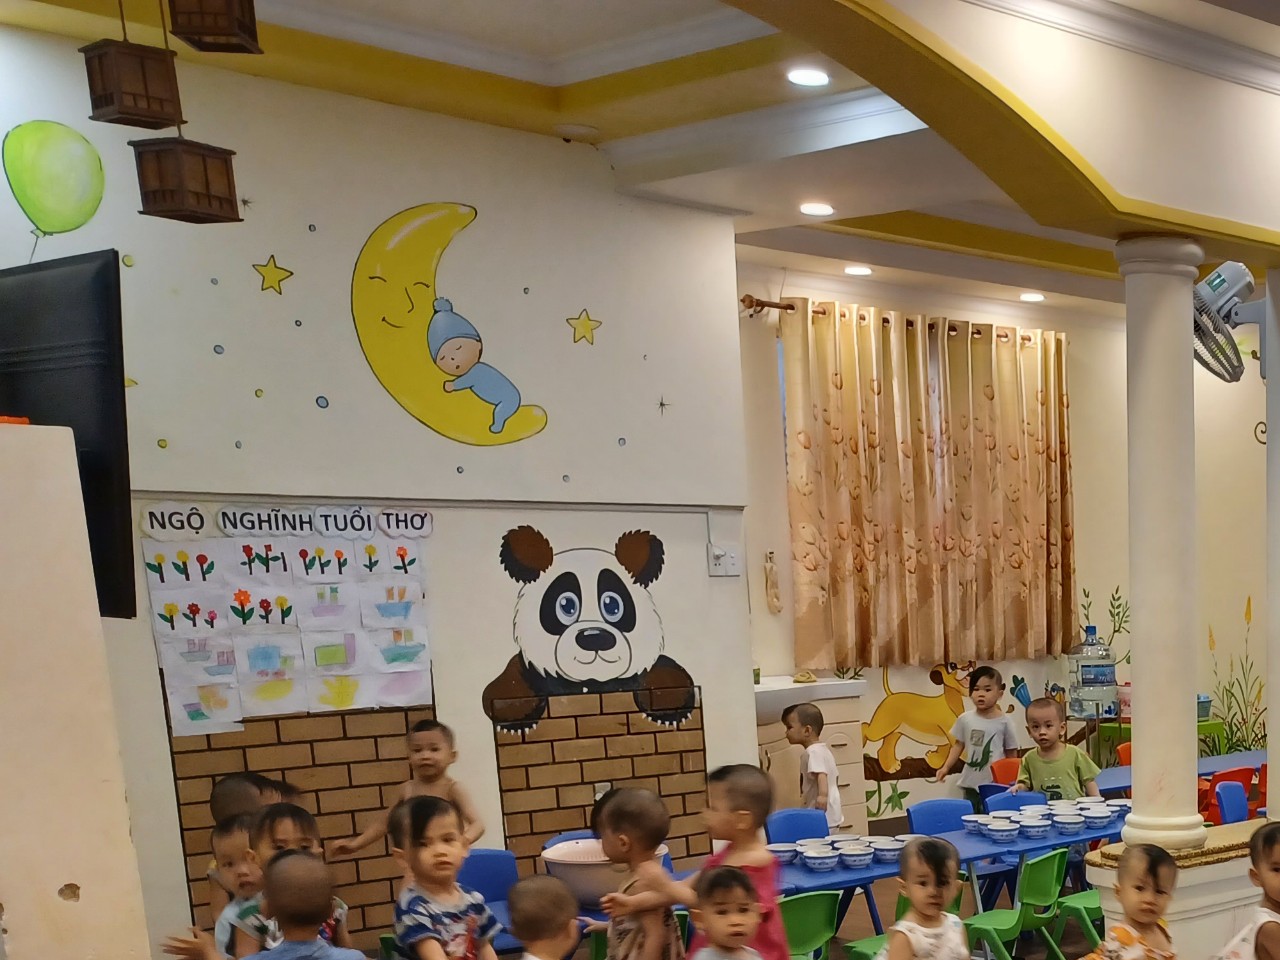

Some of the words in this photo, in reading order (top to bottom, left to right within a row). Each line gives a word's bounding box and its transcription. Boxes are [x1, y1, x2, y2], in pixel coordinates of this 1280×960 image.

[148, 507, 204, 534] NGỘ
[221, 509, 313, 531] NGHĨNH
[320, 507, 372, 531] TUỔI
[382, 513, 427, 530] THƠ
